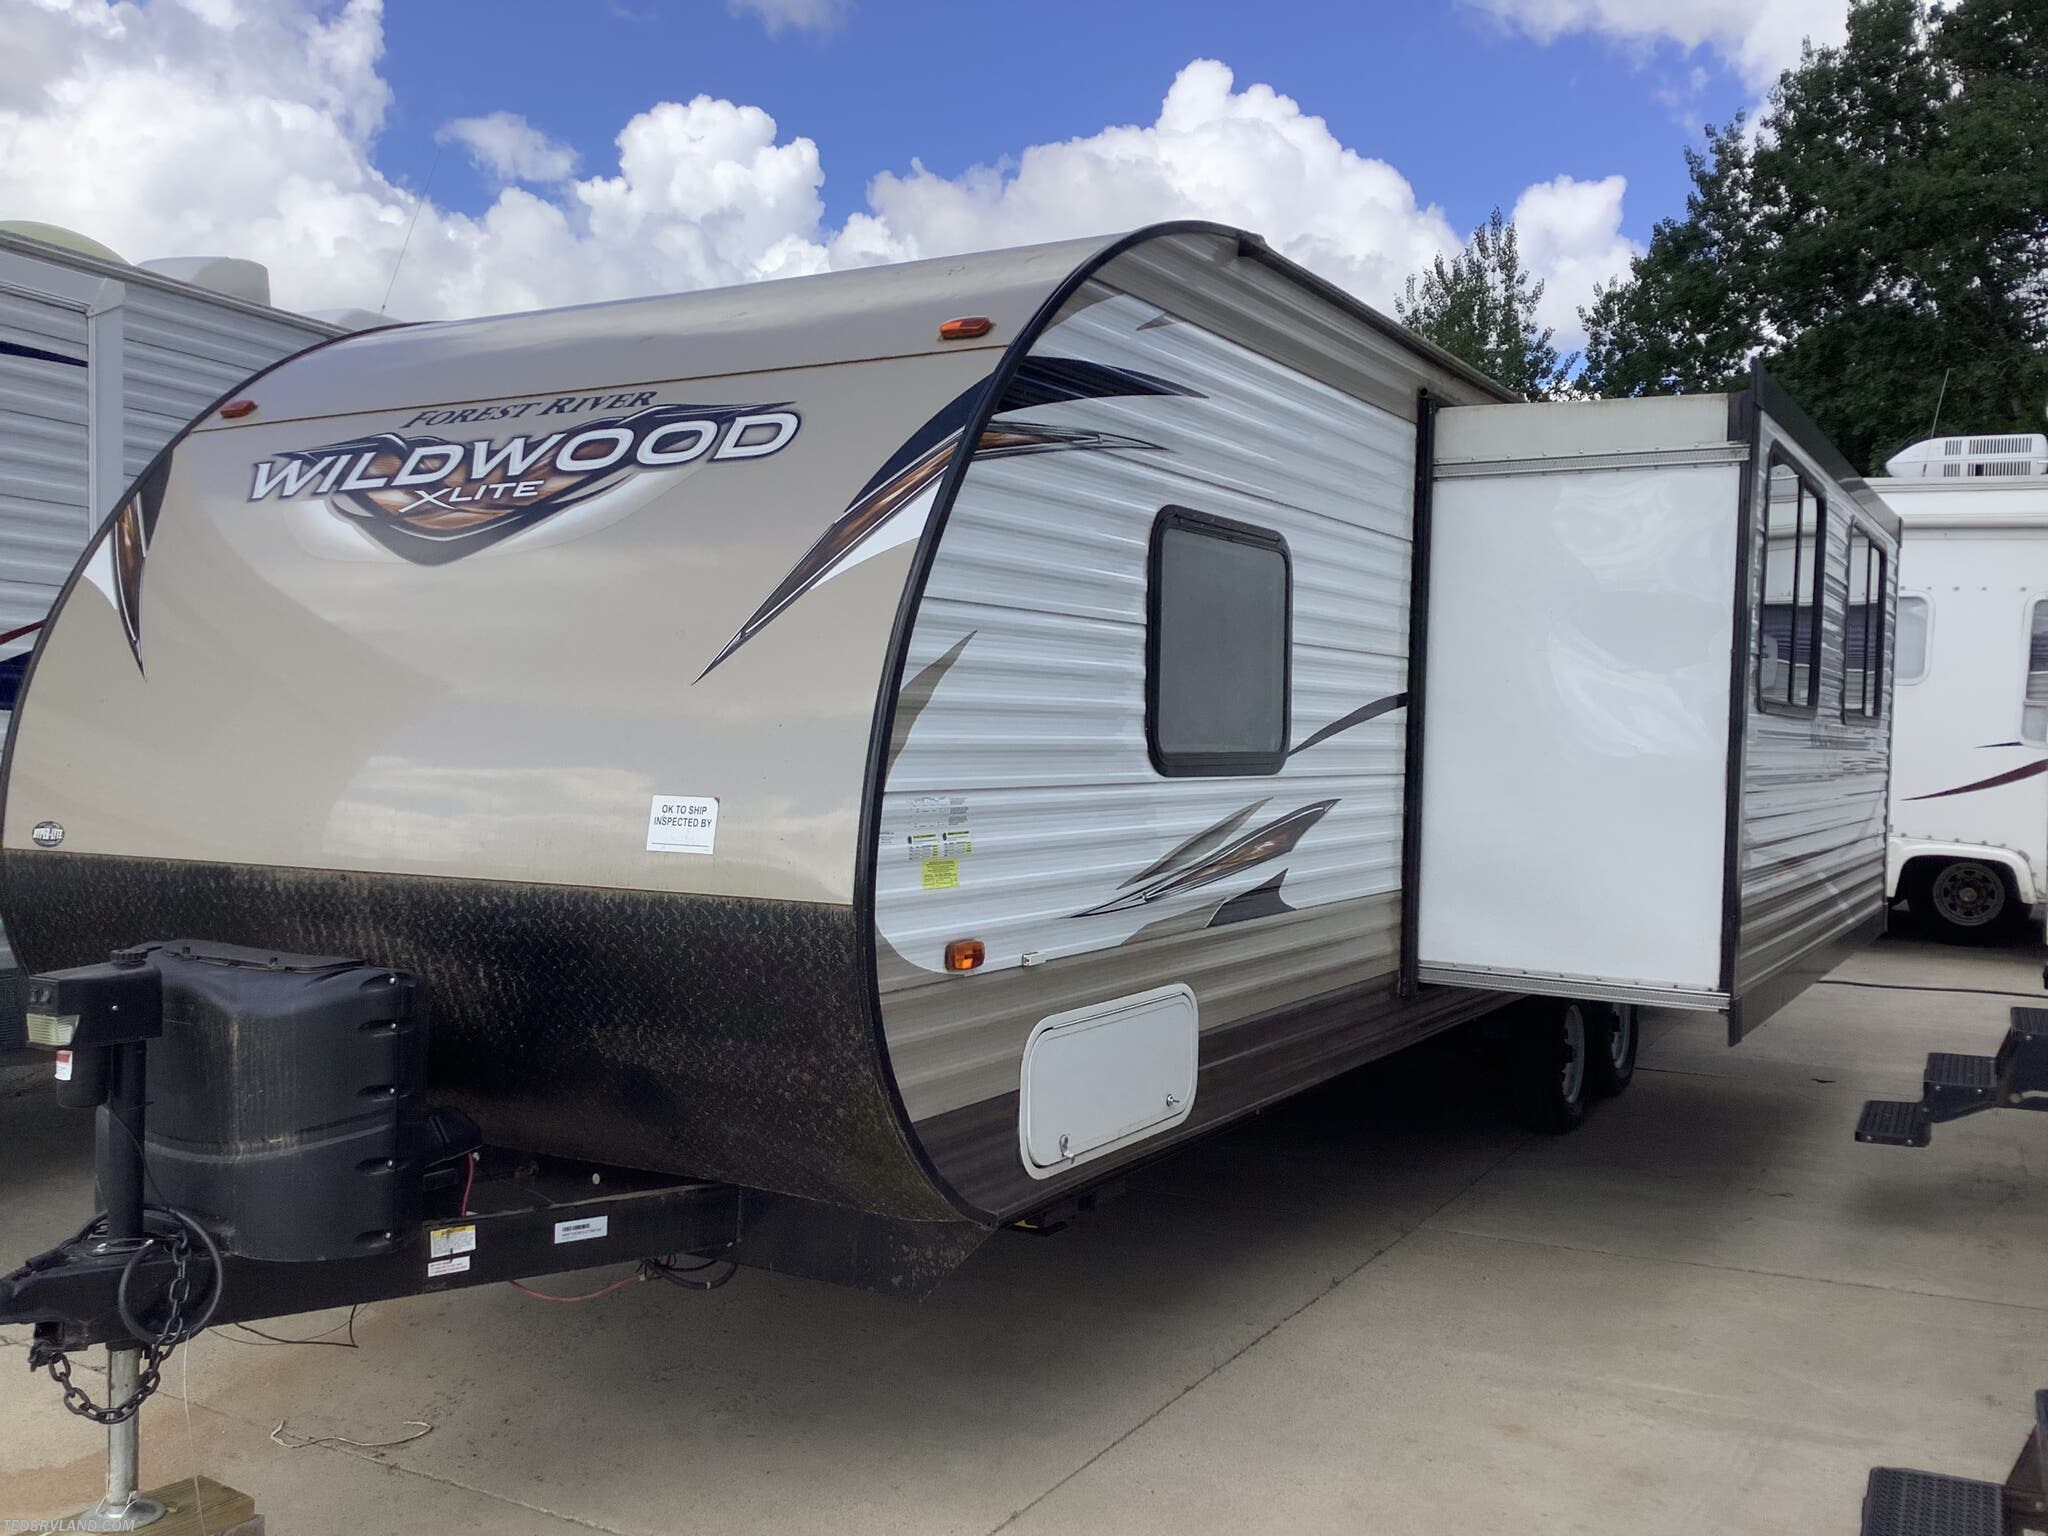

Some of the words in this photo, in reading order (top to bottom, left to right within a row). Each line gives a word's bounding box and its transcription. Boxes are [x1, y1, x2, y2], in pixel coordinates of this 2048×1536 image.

[401, 402, 539, 429] FOREST
[538, 390, 659, 416] RIVER
[248, 411, 802, 503] WILDWOOD
[398, 480, 545, 513] XLITE
[654, 816, 699, 827] INSPECTED
[700, 818, 712, 828] BY
[661, 804, 674, 814] OK
[676, 805, 687, 814] TO
[688, 805, 707, 815] SHIP
